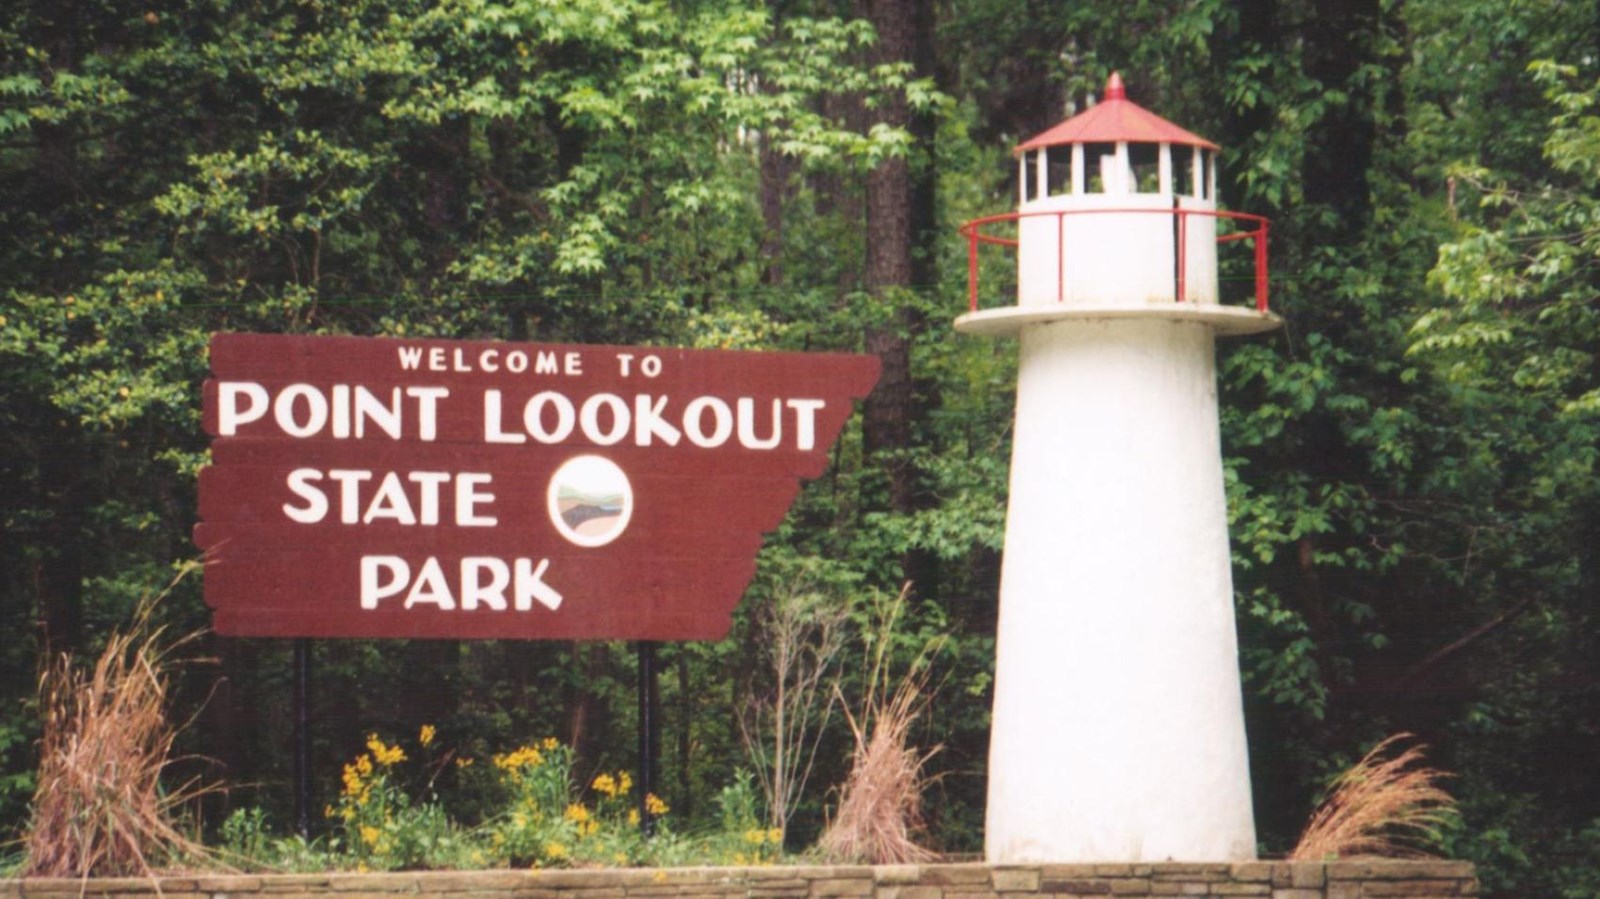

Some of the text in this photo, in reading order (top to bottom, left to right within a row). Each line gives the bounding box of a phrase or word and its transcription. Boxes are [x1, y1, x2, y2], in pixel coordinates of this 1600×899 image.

[398, 346, 663, 378] WELCOME TO
[217, 381, 826, 452] POINT LOOKOUT
[282, 467, 499, 527] STATE
[360, 555, 564, 612] PARK
